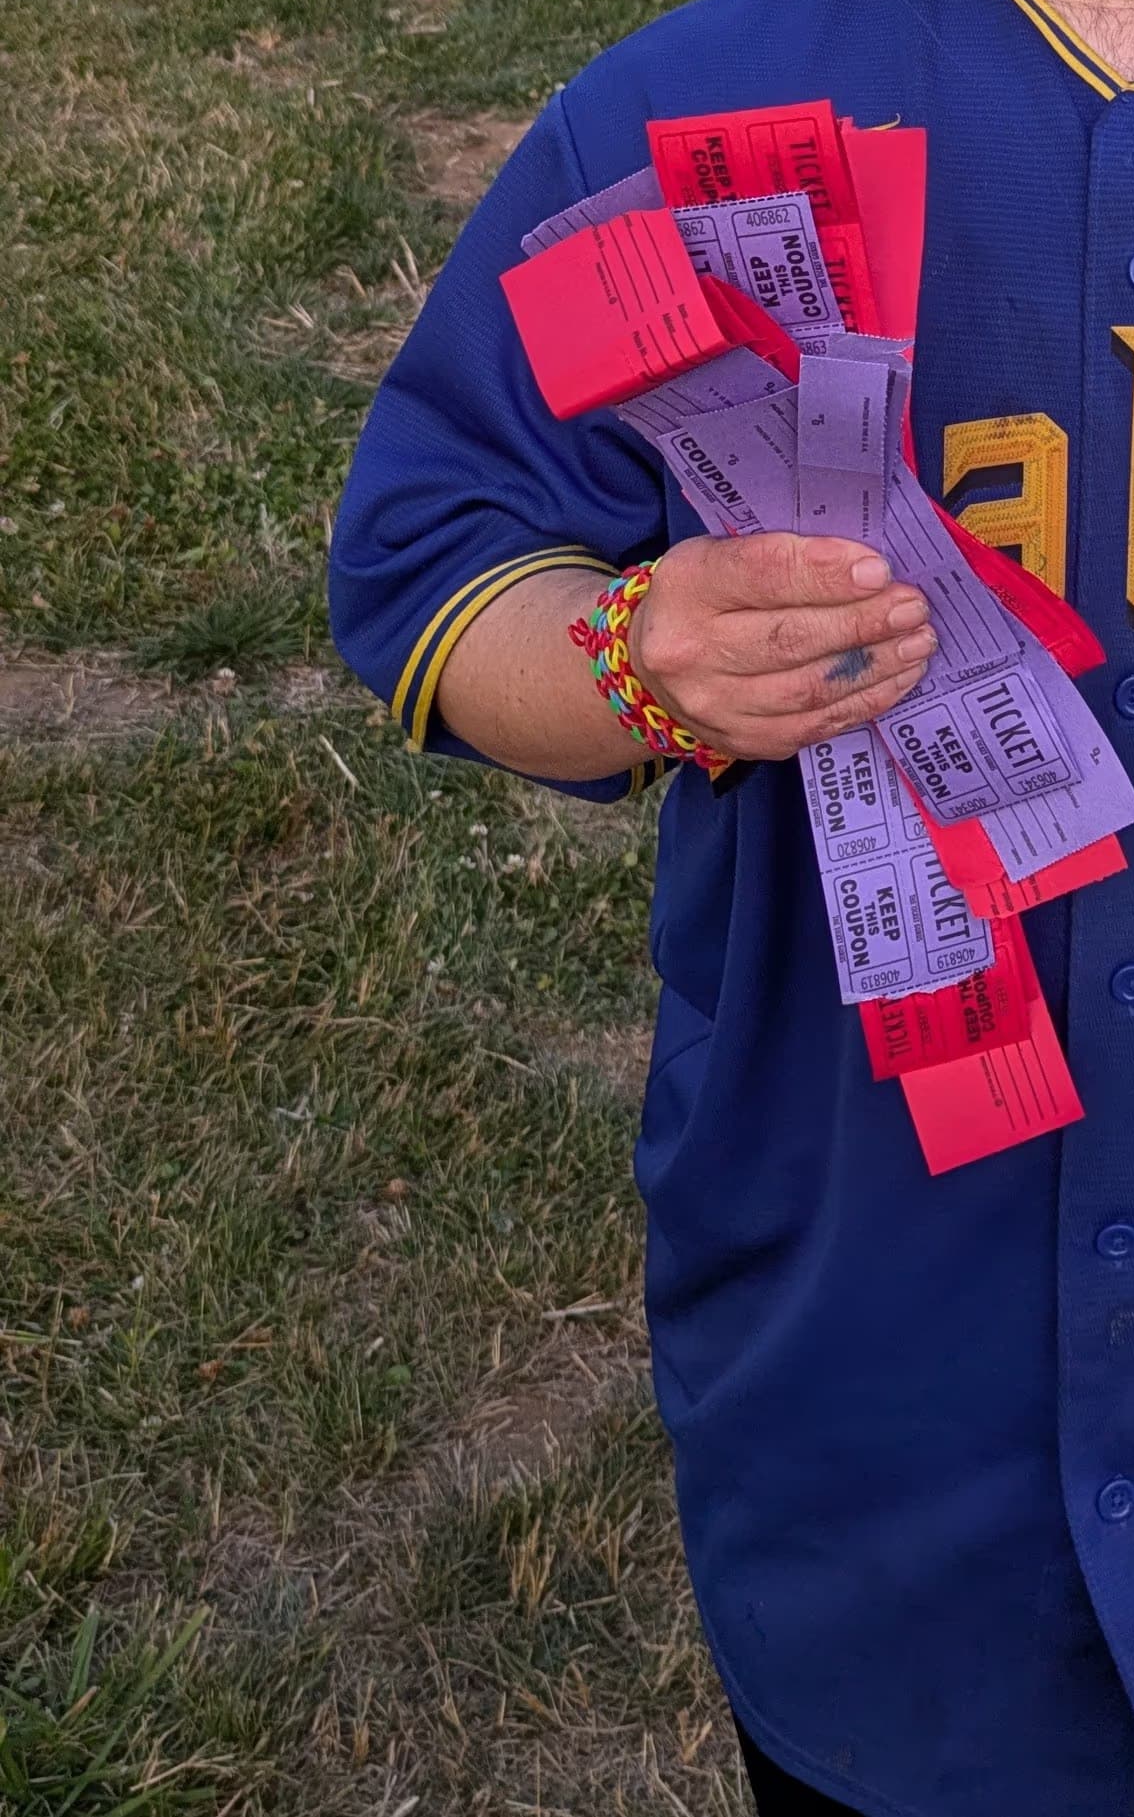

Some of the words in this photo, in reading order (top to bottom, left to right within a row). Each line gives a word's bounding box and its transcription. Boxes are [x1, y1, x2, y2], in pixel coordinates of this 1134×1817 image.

[745, 207, 791, 228] 406862
[750, 256, 782, 308] KEEP
[774, 264, 794, 297] THIS
[782, 234, 822, 318] COUPON
[679, 437, 743, 506] COUPON
[977, 682, 1046, 770] TICKET
[897, 724, 952, 800] COUPON
[927, 741, 951, 772] THIS
[935, 725, 974, 774] KEEP
[814, 743, 847, 833] COUPON
[838, 765, 855, 802] THIS
[851, 750, 877, 807] KEEP
[1018, 770, 1058, 794] 406341
[948, 795, 988, 819] 406341
[836, 835, 878, 858] 406820
[840, 879, 871, 969] COUPON
[863, 901, 880, 937] THIS
[876, 886, 901, 942] KEEP
[859, 967, 901, 991] 406819
[936, 946, 976, 971] 406819
